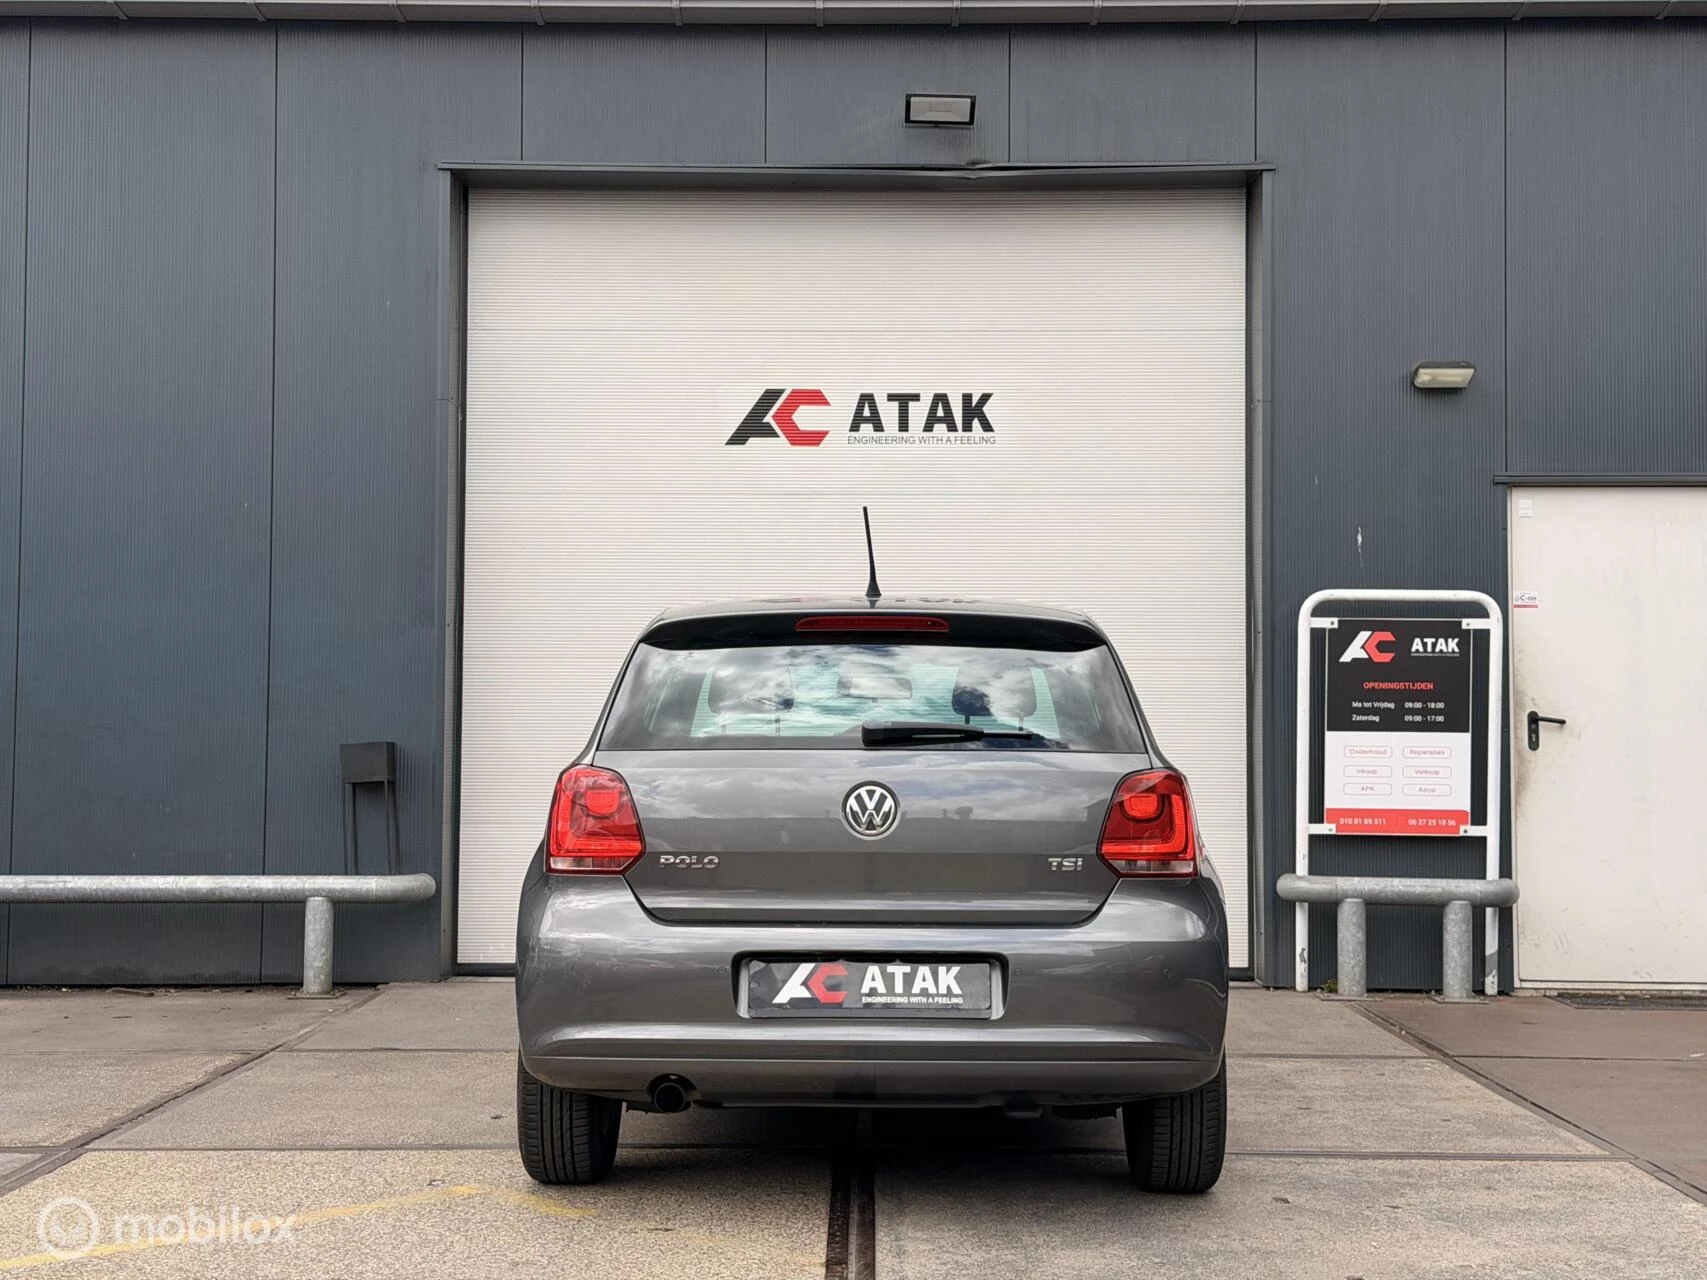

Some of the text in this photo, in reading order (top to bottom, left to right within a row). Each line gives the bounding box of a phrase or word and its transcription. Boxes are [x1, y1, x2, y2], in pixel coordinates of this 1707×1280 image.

[848, 393, 995, 432] ATAK
[847, 435, 996, 445] ENGINEERING WITH A FEELING
[1411, 637, 1460, 652] ATAK
[1363, 682, 1434, 690] OPENINGSTIJDEN
[1374, 701, 1395, 710] Vrijdag
[1352, 714, 1380, 723] Zaterdag
[1349, 748, 1387, 756] Onderhoud
[1409, 749, 1445, 757] Reparaties
[1356, 768, 1377, 776] Inkoop
[1414, 768, 1440, 777] Verkoop
[659, 855, 719, 869] POLO
[1048, 857, 1083, 871] TSI
[860, 965, 963, 994] ATAK
